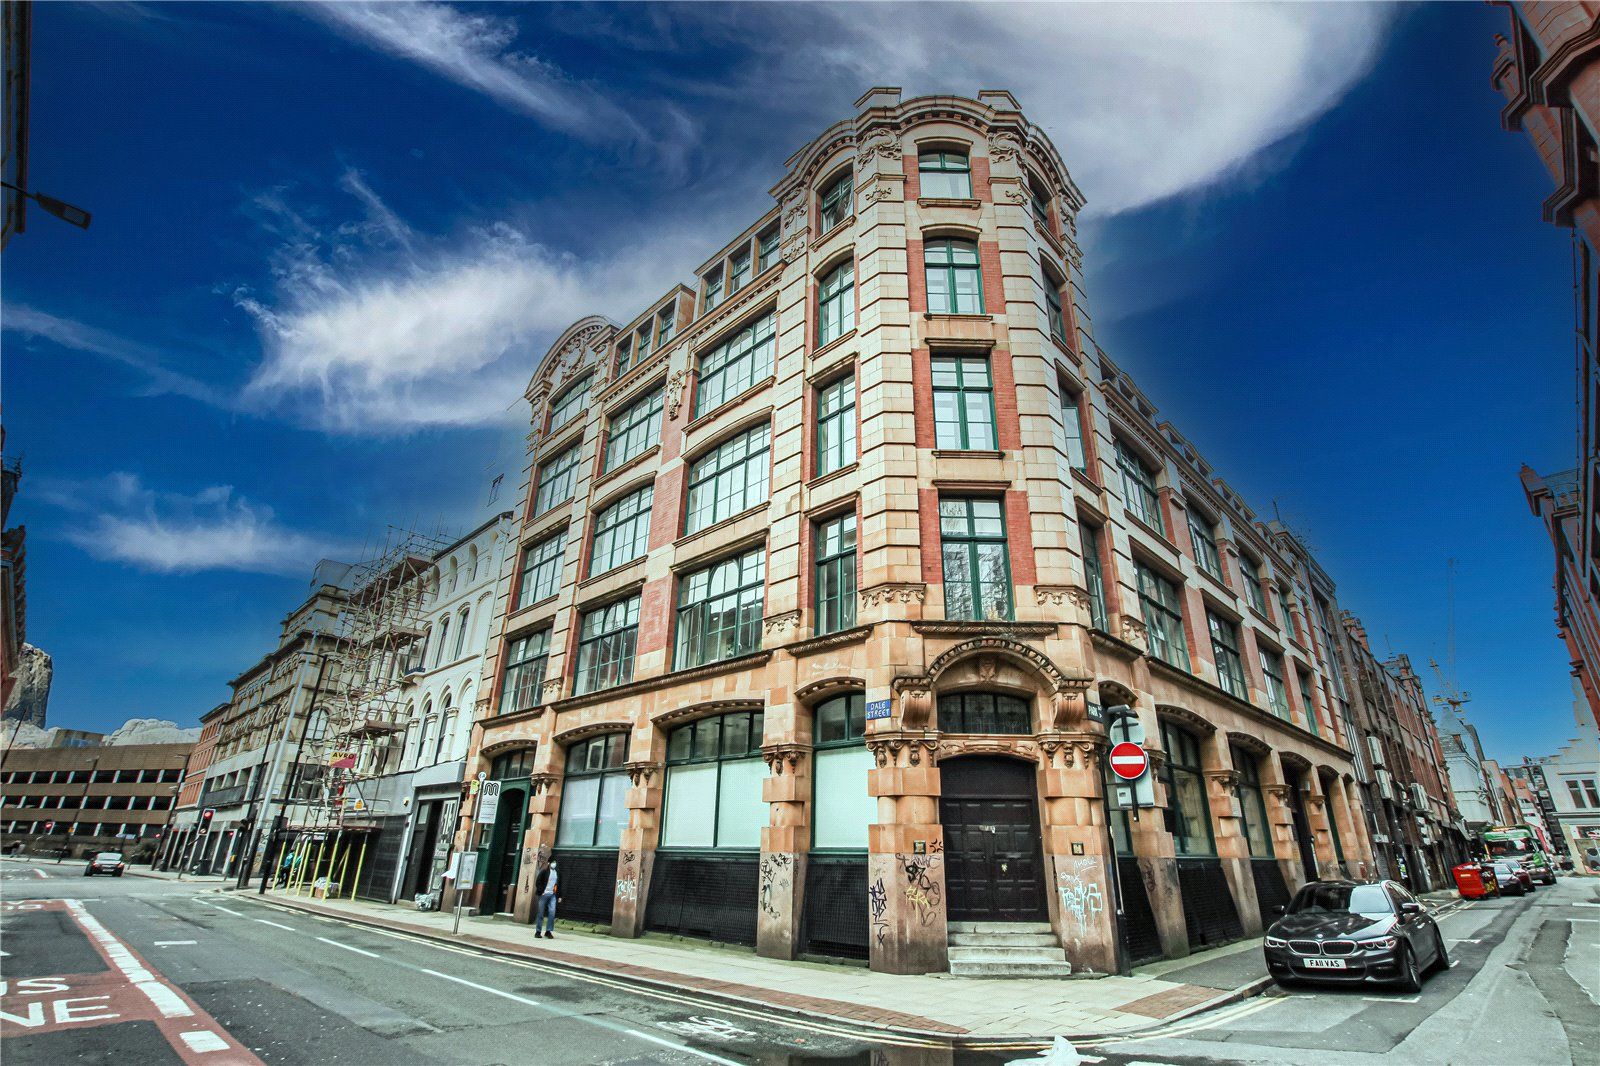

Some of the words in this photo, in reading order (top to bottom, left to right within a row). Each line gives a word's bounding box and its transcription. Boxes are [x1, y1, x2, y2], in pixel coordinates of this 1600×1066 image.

[870, 701, 886, 710] DALE
[867, 708, 890, 718] STREET
[0, 977, 70, 997] S
